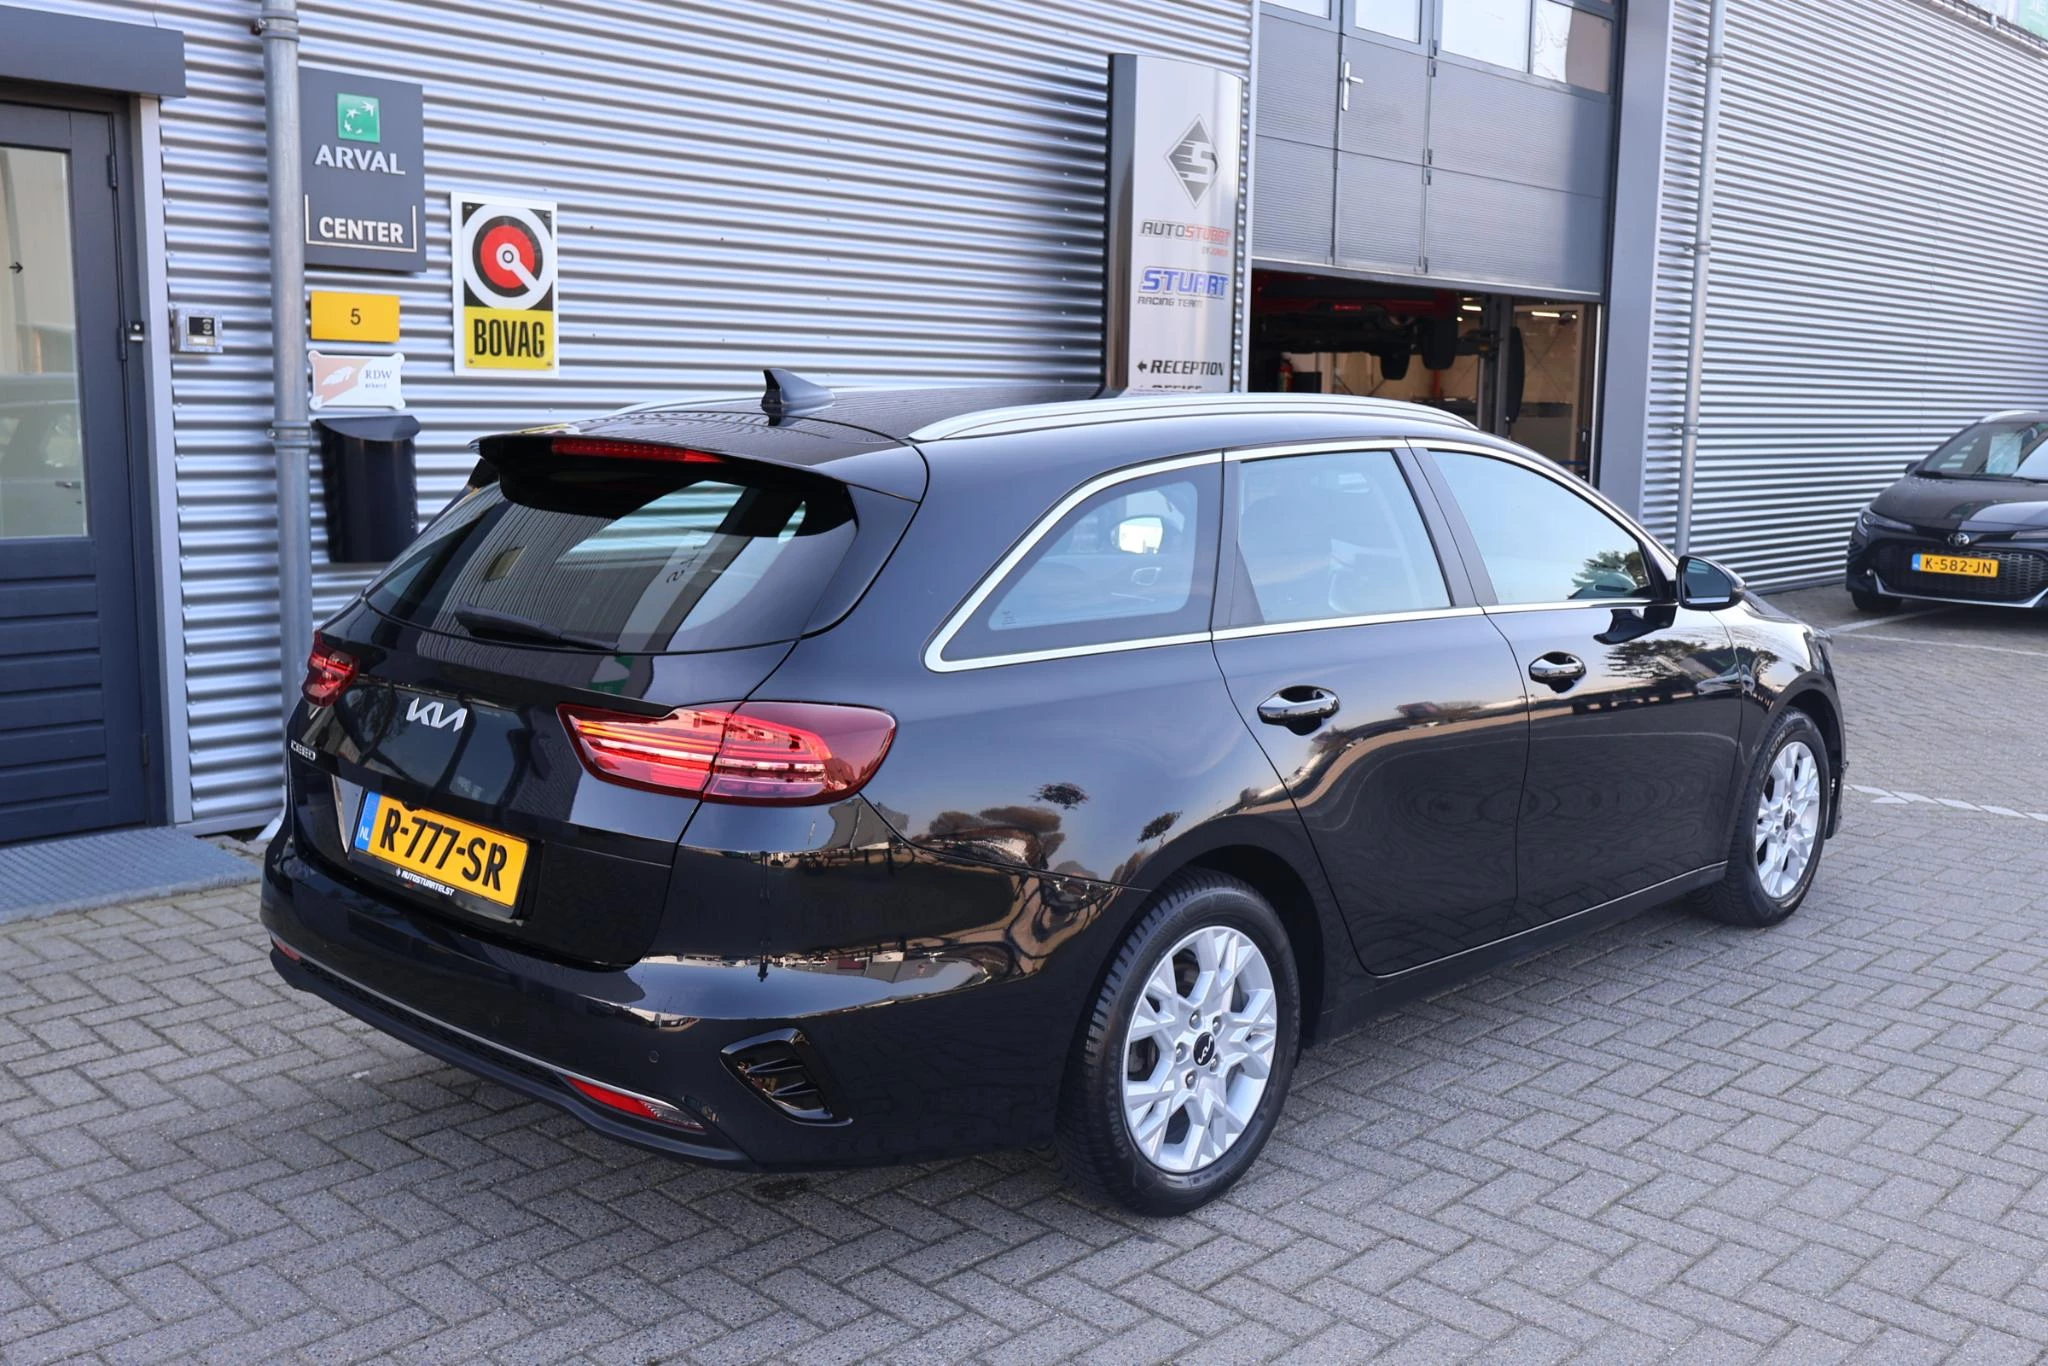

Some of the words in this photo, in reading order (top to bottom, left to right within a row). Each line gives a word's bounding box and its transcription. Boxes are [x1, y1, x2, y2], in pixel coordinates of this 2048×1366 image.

[314, 144, 406, 176] ARVAL
[319, 216, 404, 244] CENTER
[1141, 269, 1229, 297] STUART
[1137, 296, 1175, 306] RACING
[350, 308, 361, 325] 5
[473, 318, 545, 358] BOVAG
[365, 369, 392, 380] RDW
[1150, 359, 1225, 376] RECEPTION
[1925, 557, 1992, 574] K-582-JN
[405, 697, 468, 732] KIA
[359, 824, 370, 841] NL
[379, 808, 508, 892] R-777-SR
